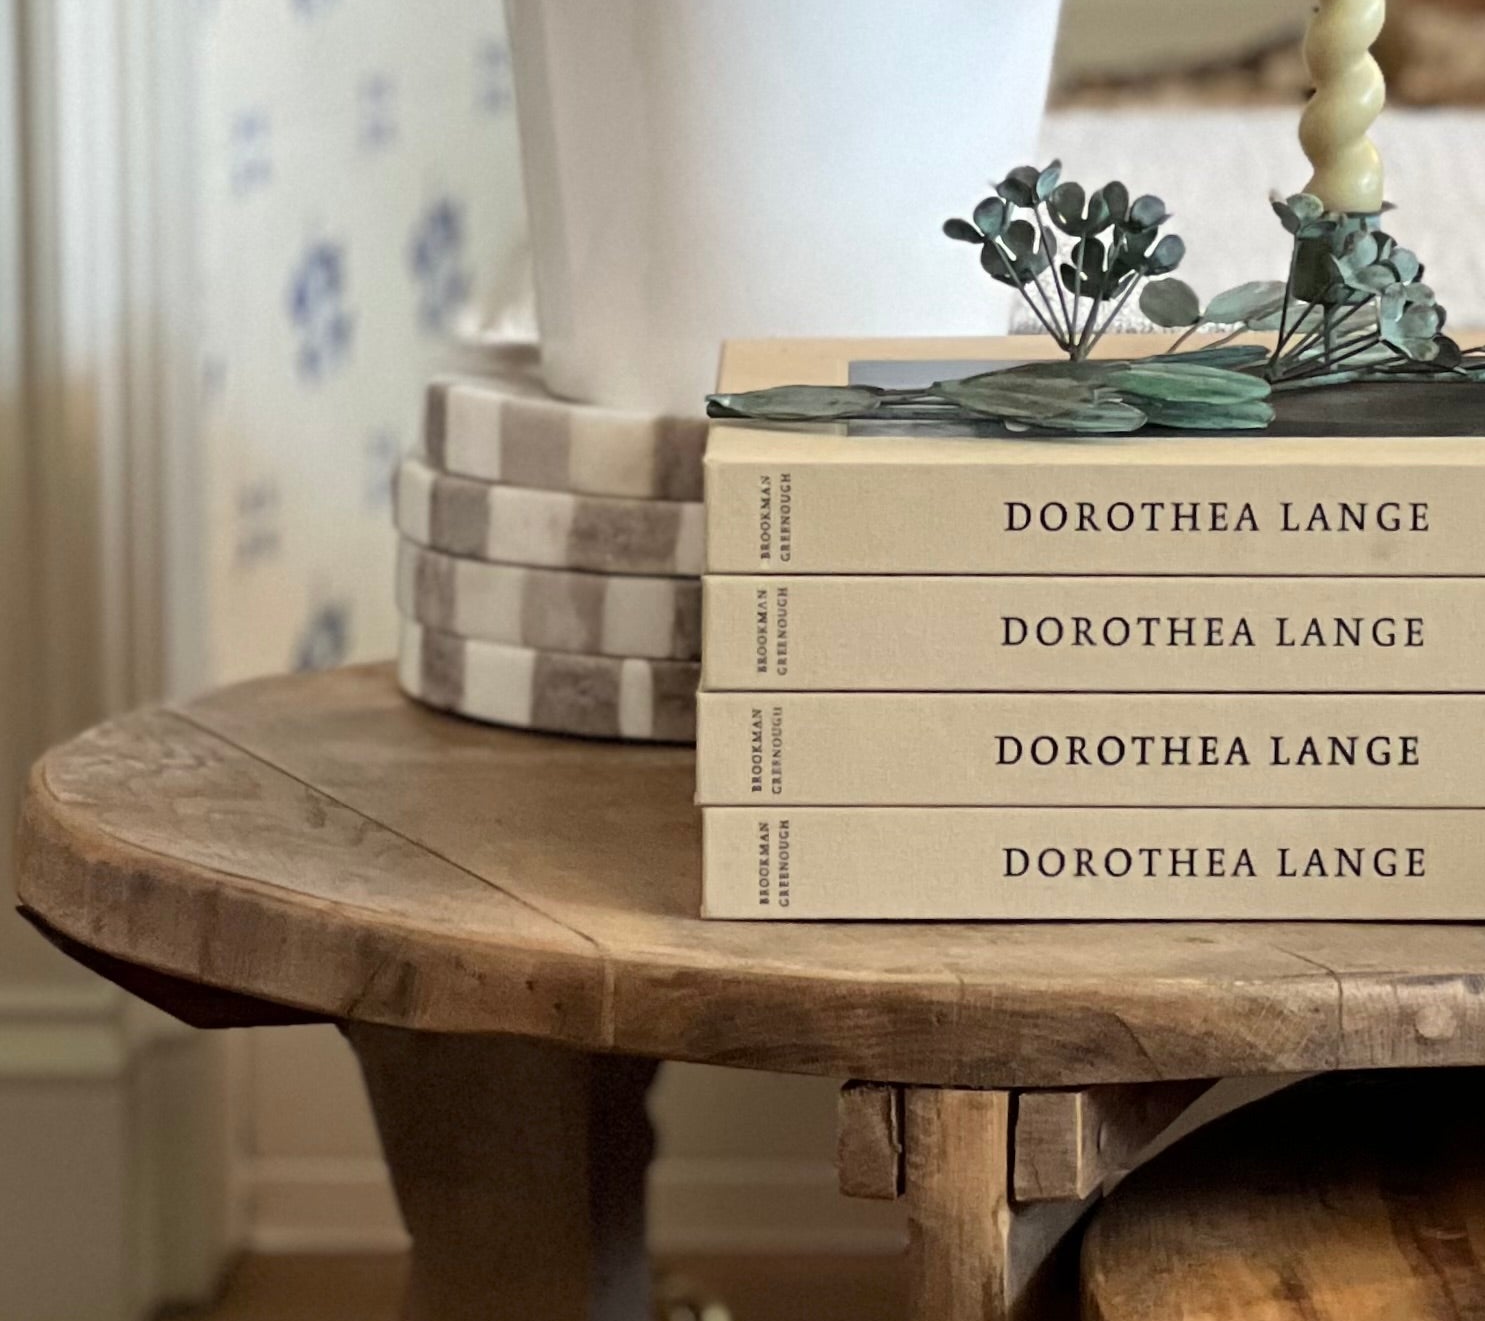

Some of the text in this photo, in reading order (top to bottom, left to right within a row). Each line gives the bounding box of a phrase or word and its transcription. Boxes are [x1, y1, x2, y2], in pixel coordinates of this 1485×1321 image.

[759, 475, 772, 560] BROOKMAN
[779, 473, 792, 562] GREENOUGH
[1003, 501, 1429, 532] DOROTHEA LANGE
[756, 589, 768, 673] BROOKMAN
[776, 587, 788, 676] GREENOUGH
[1000, 616, 1424, 648] DOROTHEA LANGE
[751, 708, 763, 793] BROOKMAN
[771, 706, 783, 795] GREENOUGH
[993, 735, 1420, 767] DOROTHEA LANGE
[758, 821, 770, 905] BROOKMAN
[778, 819, 790, 908] GREENOUGH
[1002, 847, 1426, 878] DOROTHEA LANGE
